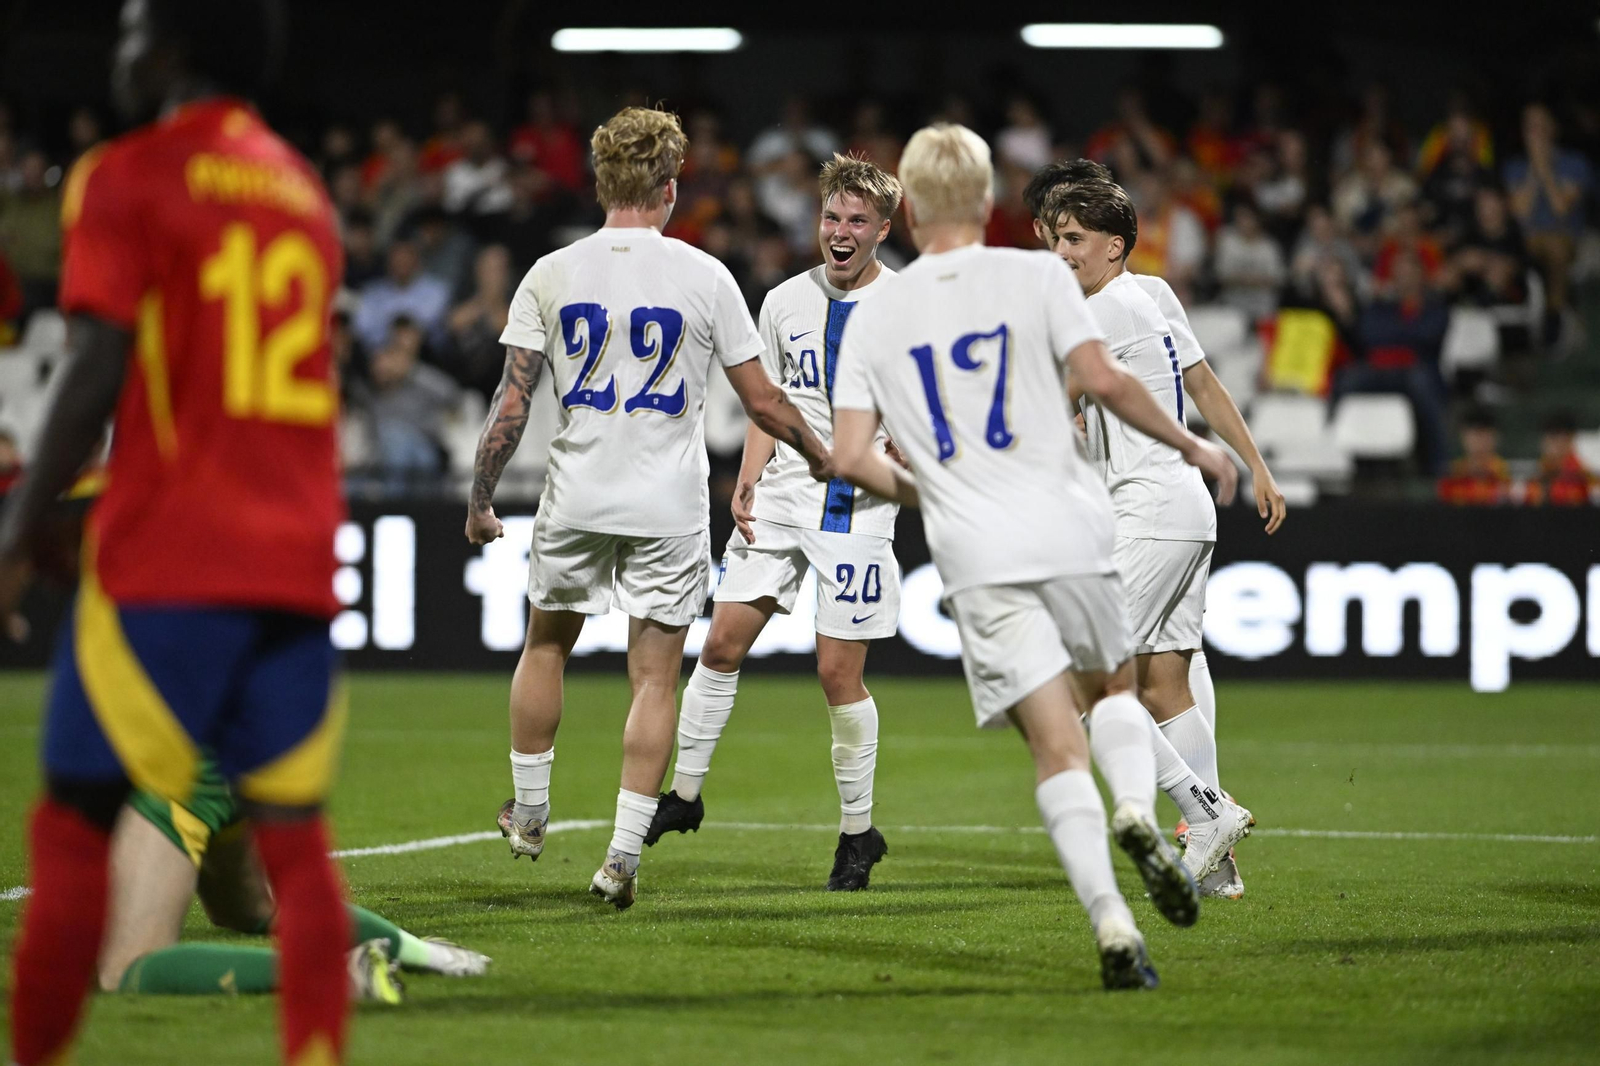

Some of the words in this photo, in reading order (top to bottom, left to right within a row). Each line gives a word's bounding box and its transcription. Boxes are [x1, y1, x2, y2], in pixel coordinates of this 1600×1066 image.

[202, 224, 334, 427] 12
[559, 302, 689, 419] 22
[909, 322, 1018, 464] 17
[835, 563, 881, 604] 20
